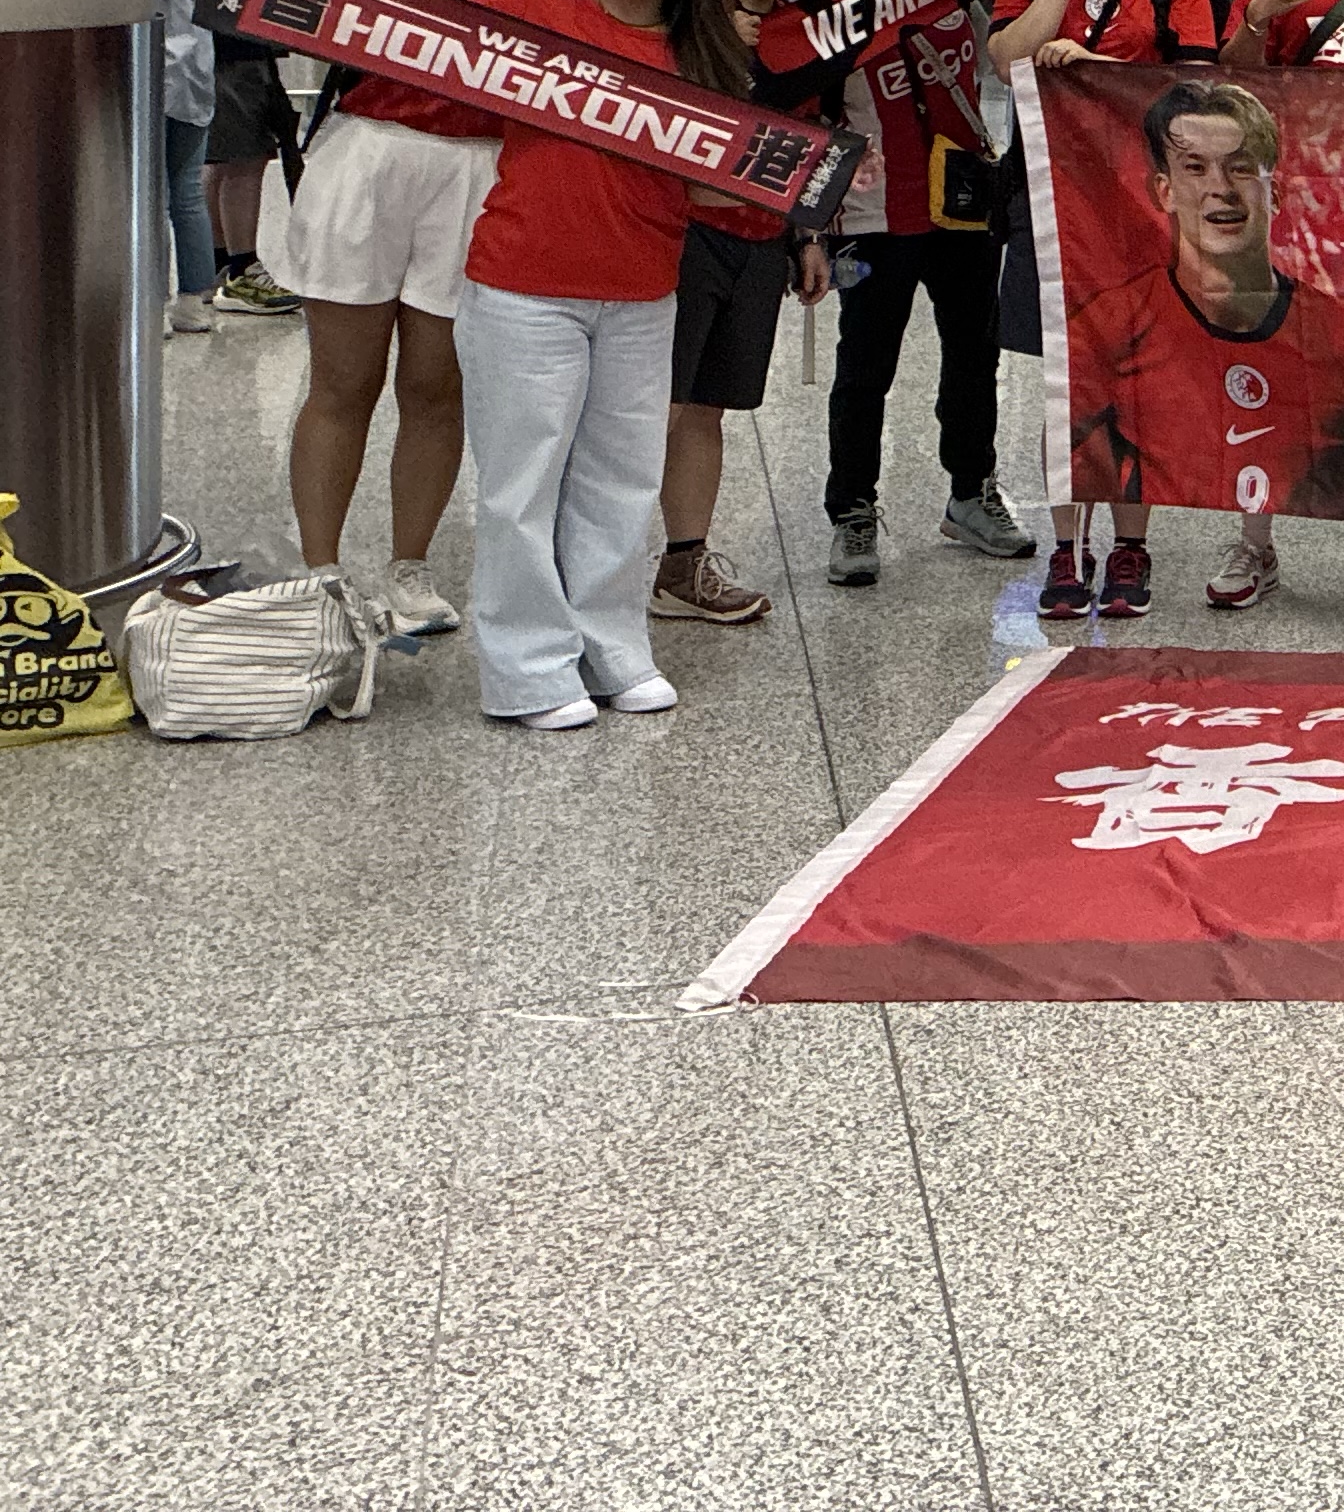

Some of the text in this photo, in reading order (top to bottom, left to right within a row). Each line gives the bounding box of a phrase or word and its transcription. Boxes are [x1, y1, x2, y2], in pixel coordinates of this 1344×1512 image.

[331, 3, 734, 170] HONGKONG
[477, 24, 626, 92] WE ARE
[730, 122, 816, 198] 港
[1098, 701, 1286, 729] THE
